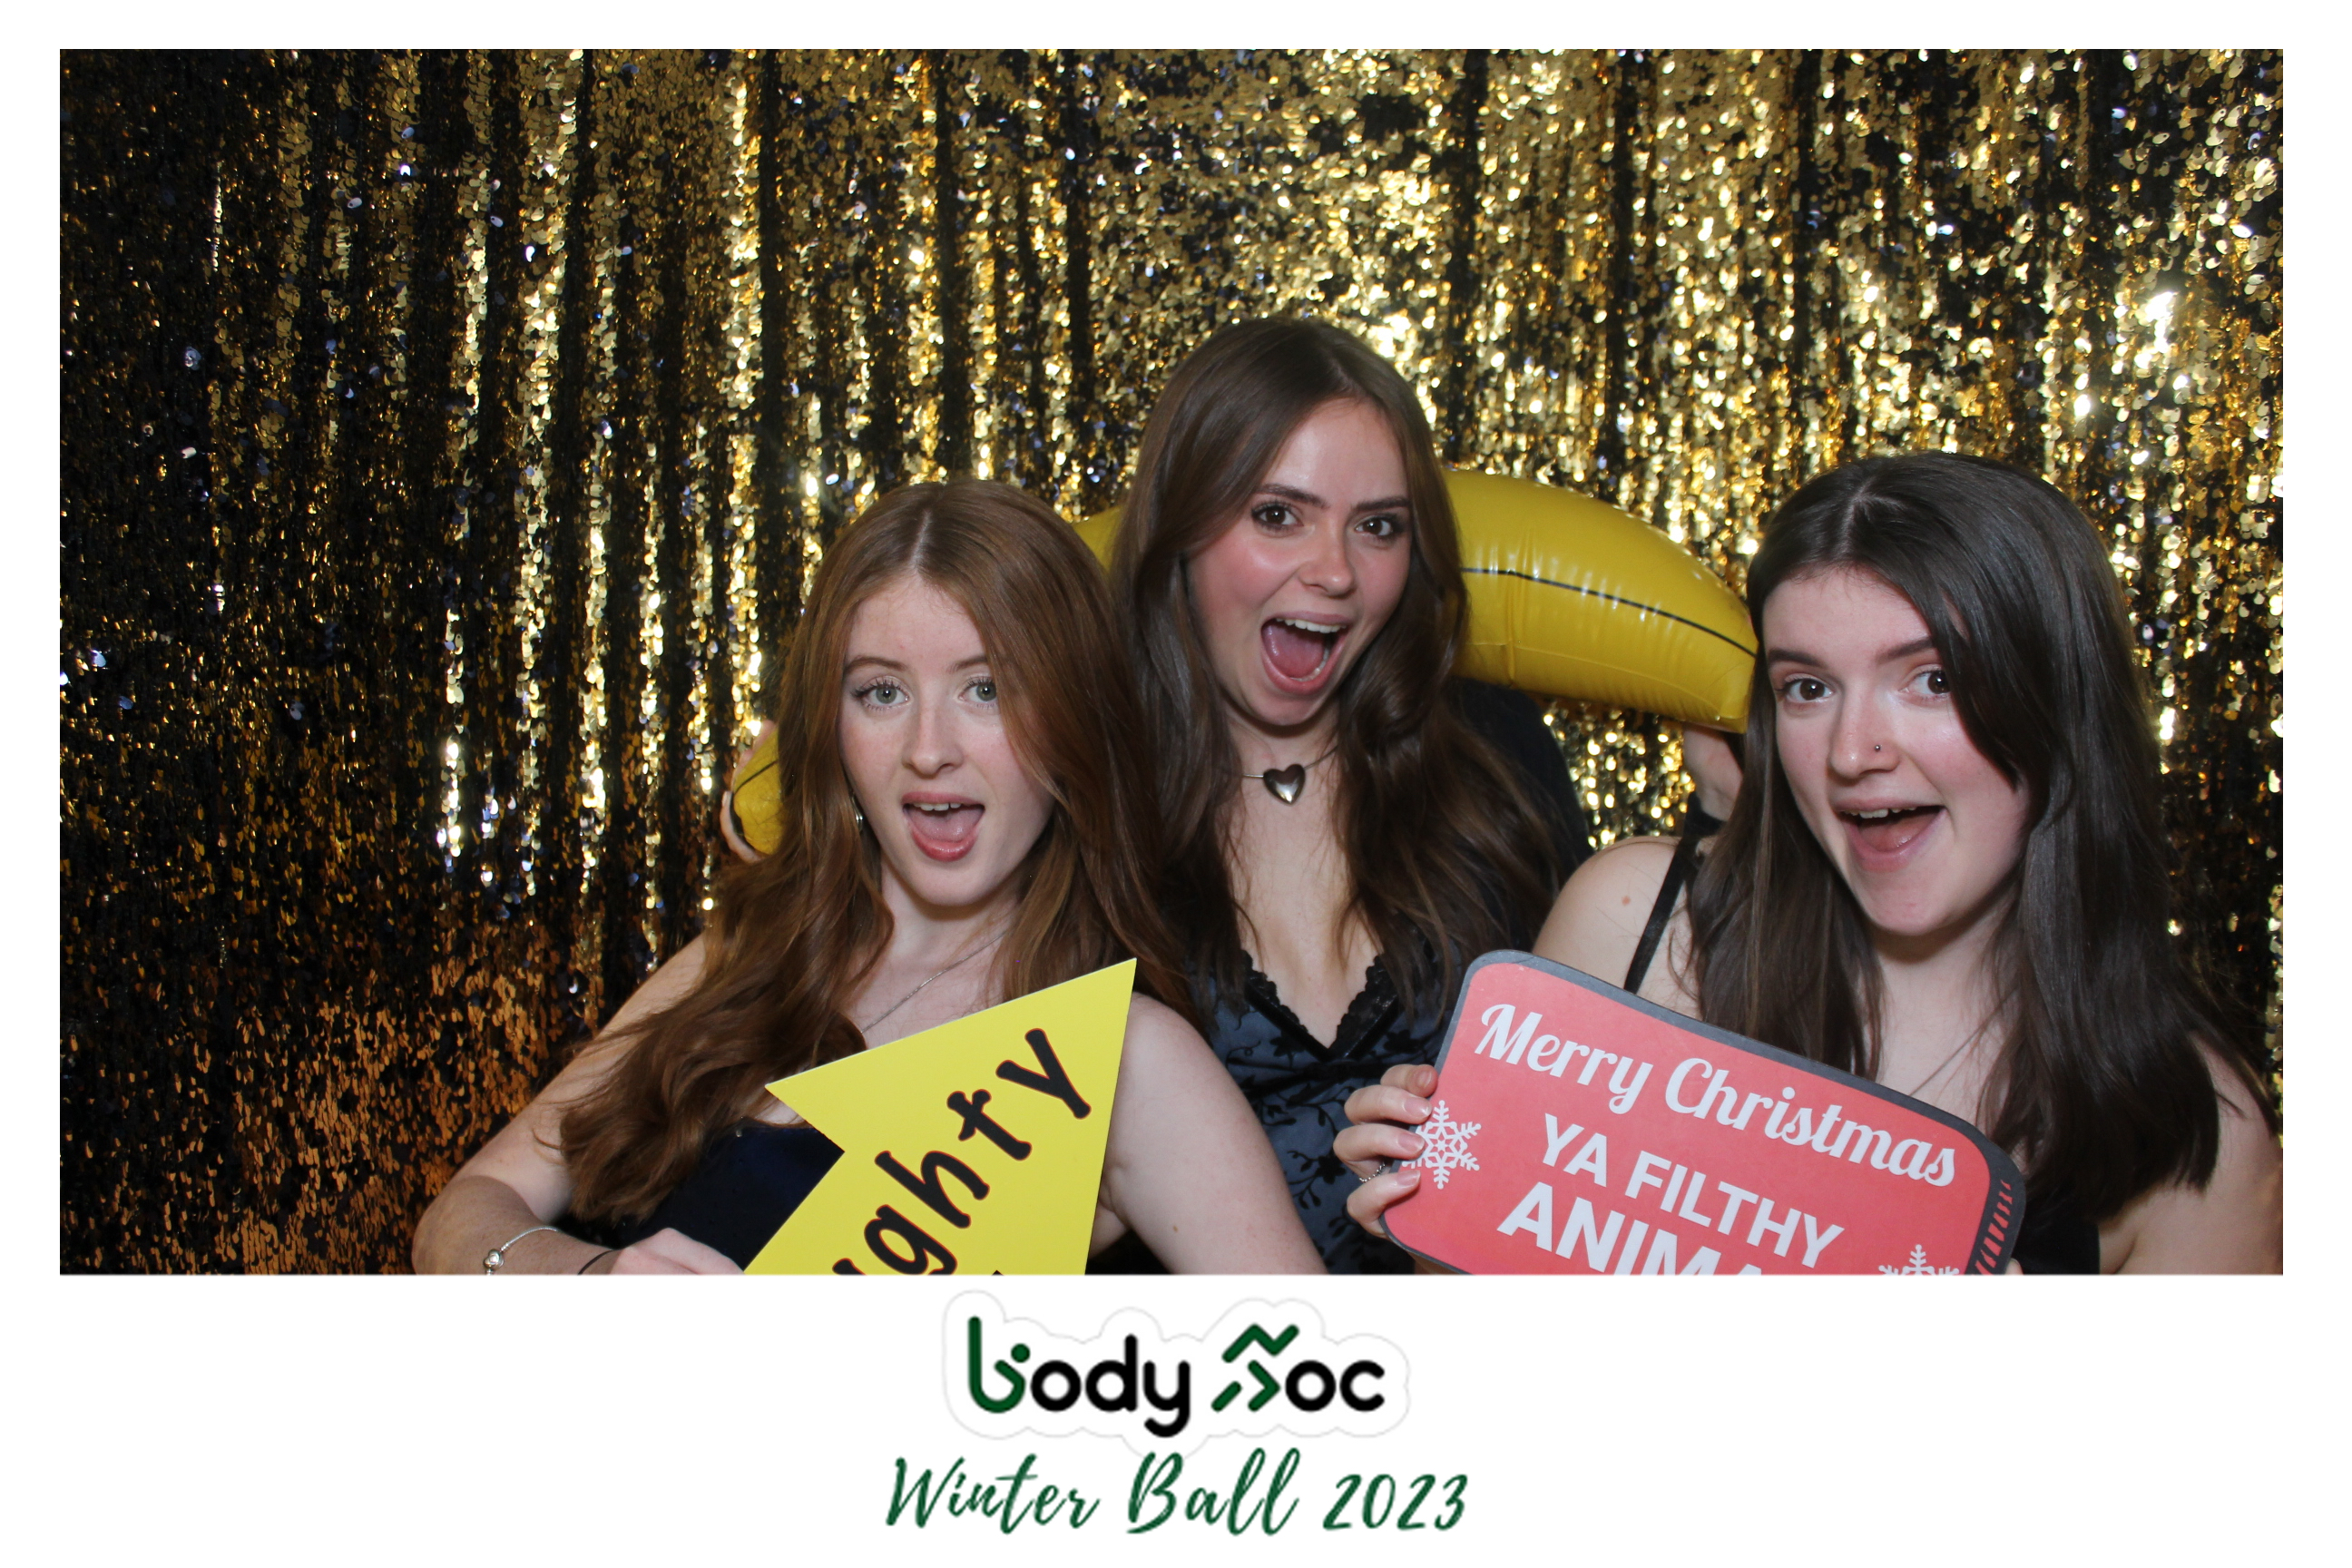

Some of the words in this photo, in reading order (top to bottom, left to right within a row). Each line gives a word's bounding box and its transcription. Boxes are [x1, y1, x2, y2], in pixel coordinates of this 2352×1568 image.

[831, 1027, 1093, 1276] ghty
[1474, 1003, 1654, 1115] Merry
[1664, 1057, 1956, 1187] Christmas
[1496, 1181, 1762, 1276] ANIM
[1541, 1112, 1610, 1188] YA
[1624, 1150, 1846, 1269] FILTHY
